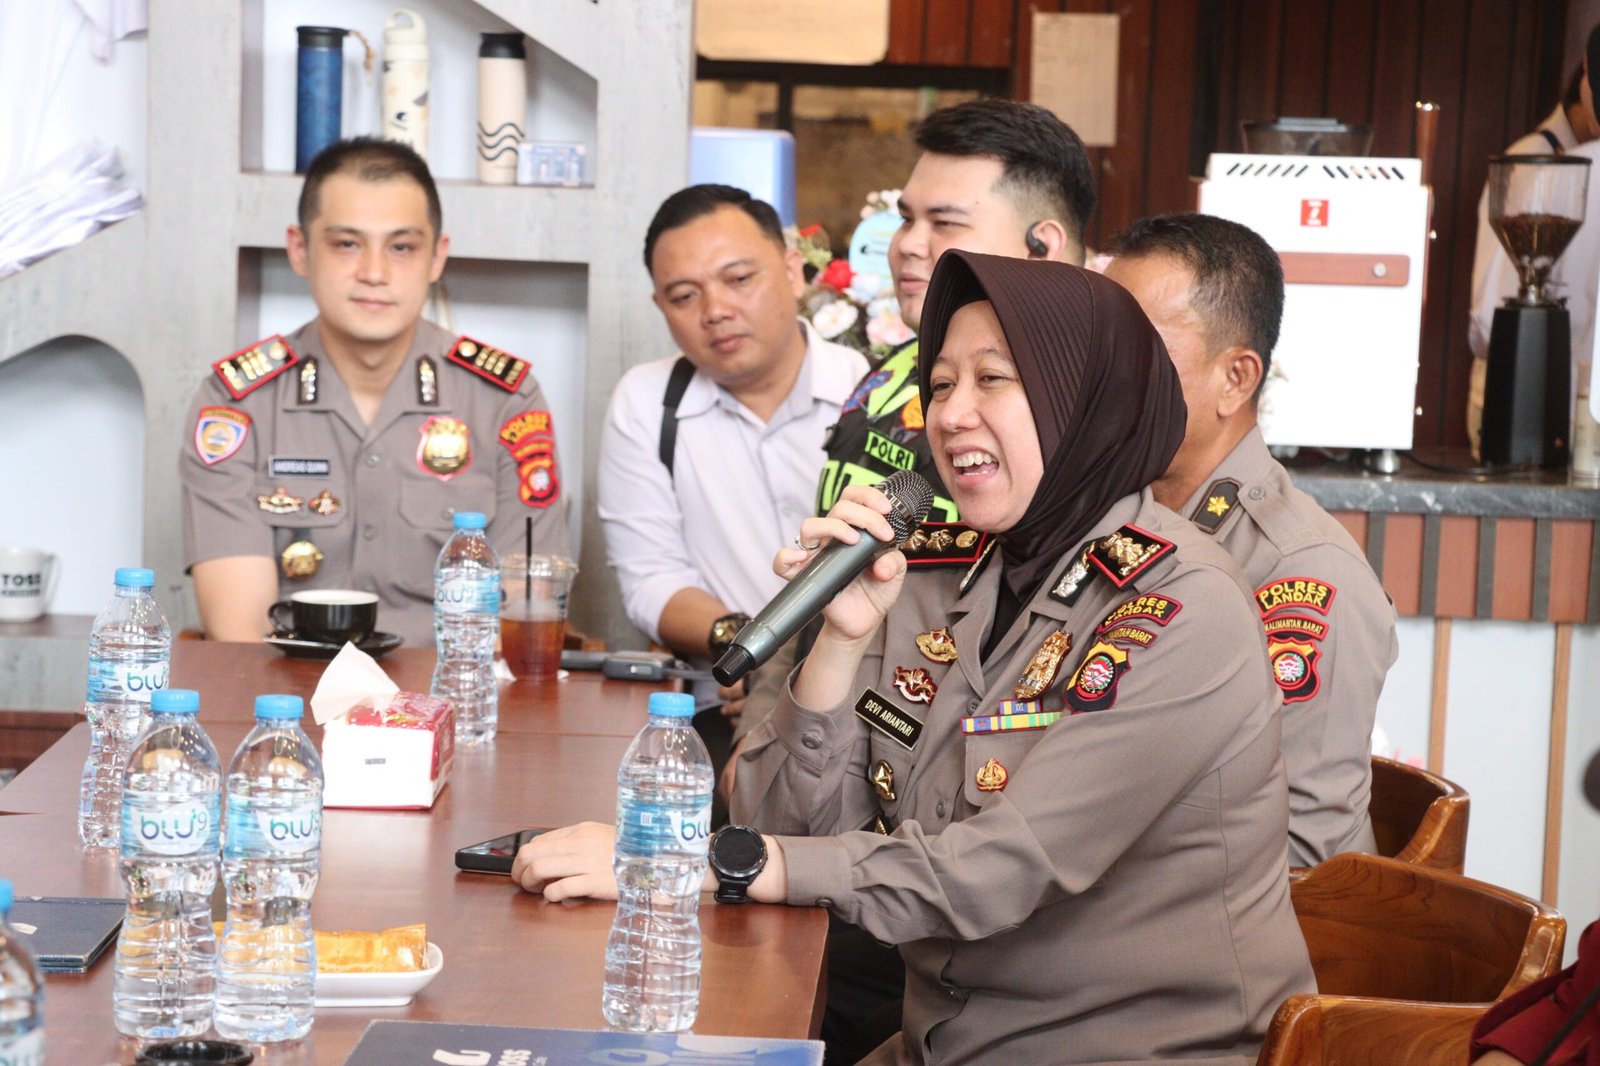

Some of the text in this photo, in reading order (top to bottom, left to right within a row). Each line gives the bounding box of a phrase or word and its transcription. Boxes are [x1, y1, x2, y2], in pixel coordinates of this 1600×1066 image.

[869, 436, 911, 470] POLRI
[1259, 581, 1328, 604] POLRES
[1264, 592, 1324, 610] LANDAK
[1129, 629, 1153, 644] BARAT
[1303, 620, 1324, 635] BARAT
[864, 699, 915, 737] DEVI ARIANTARI
